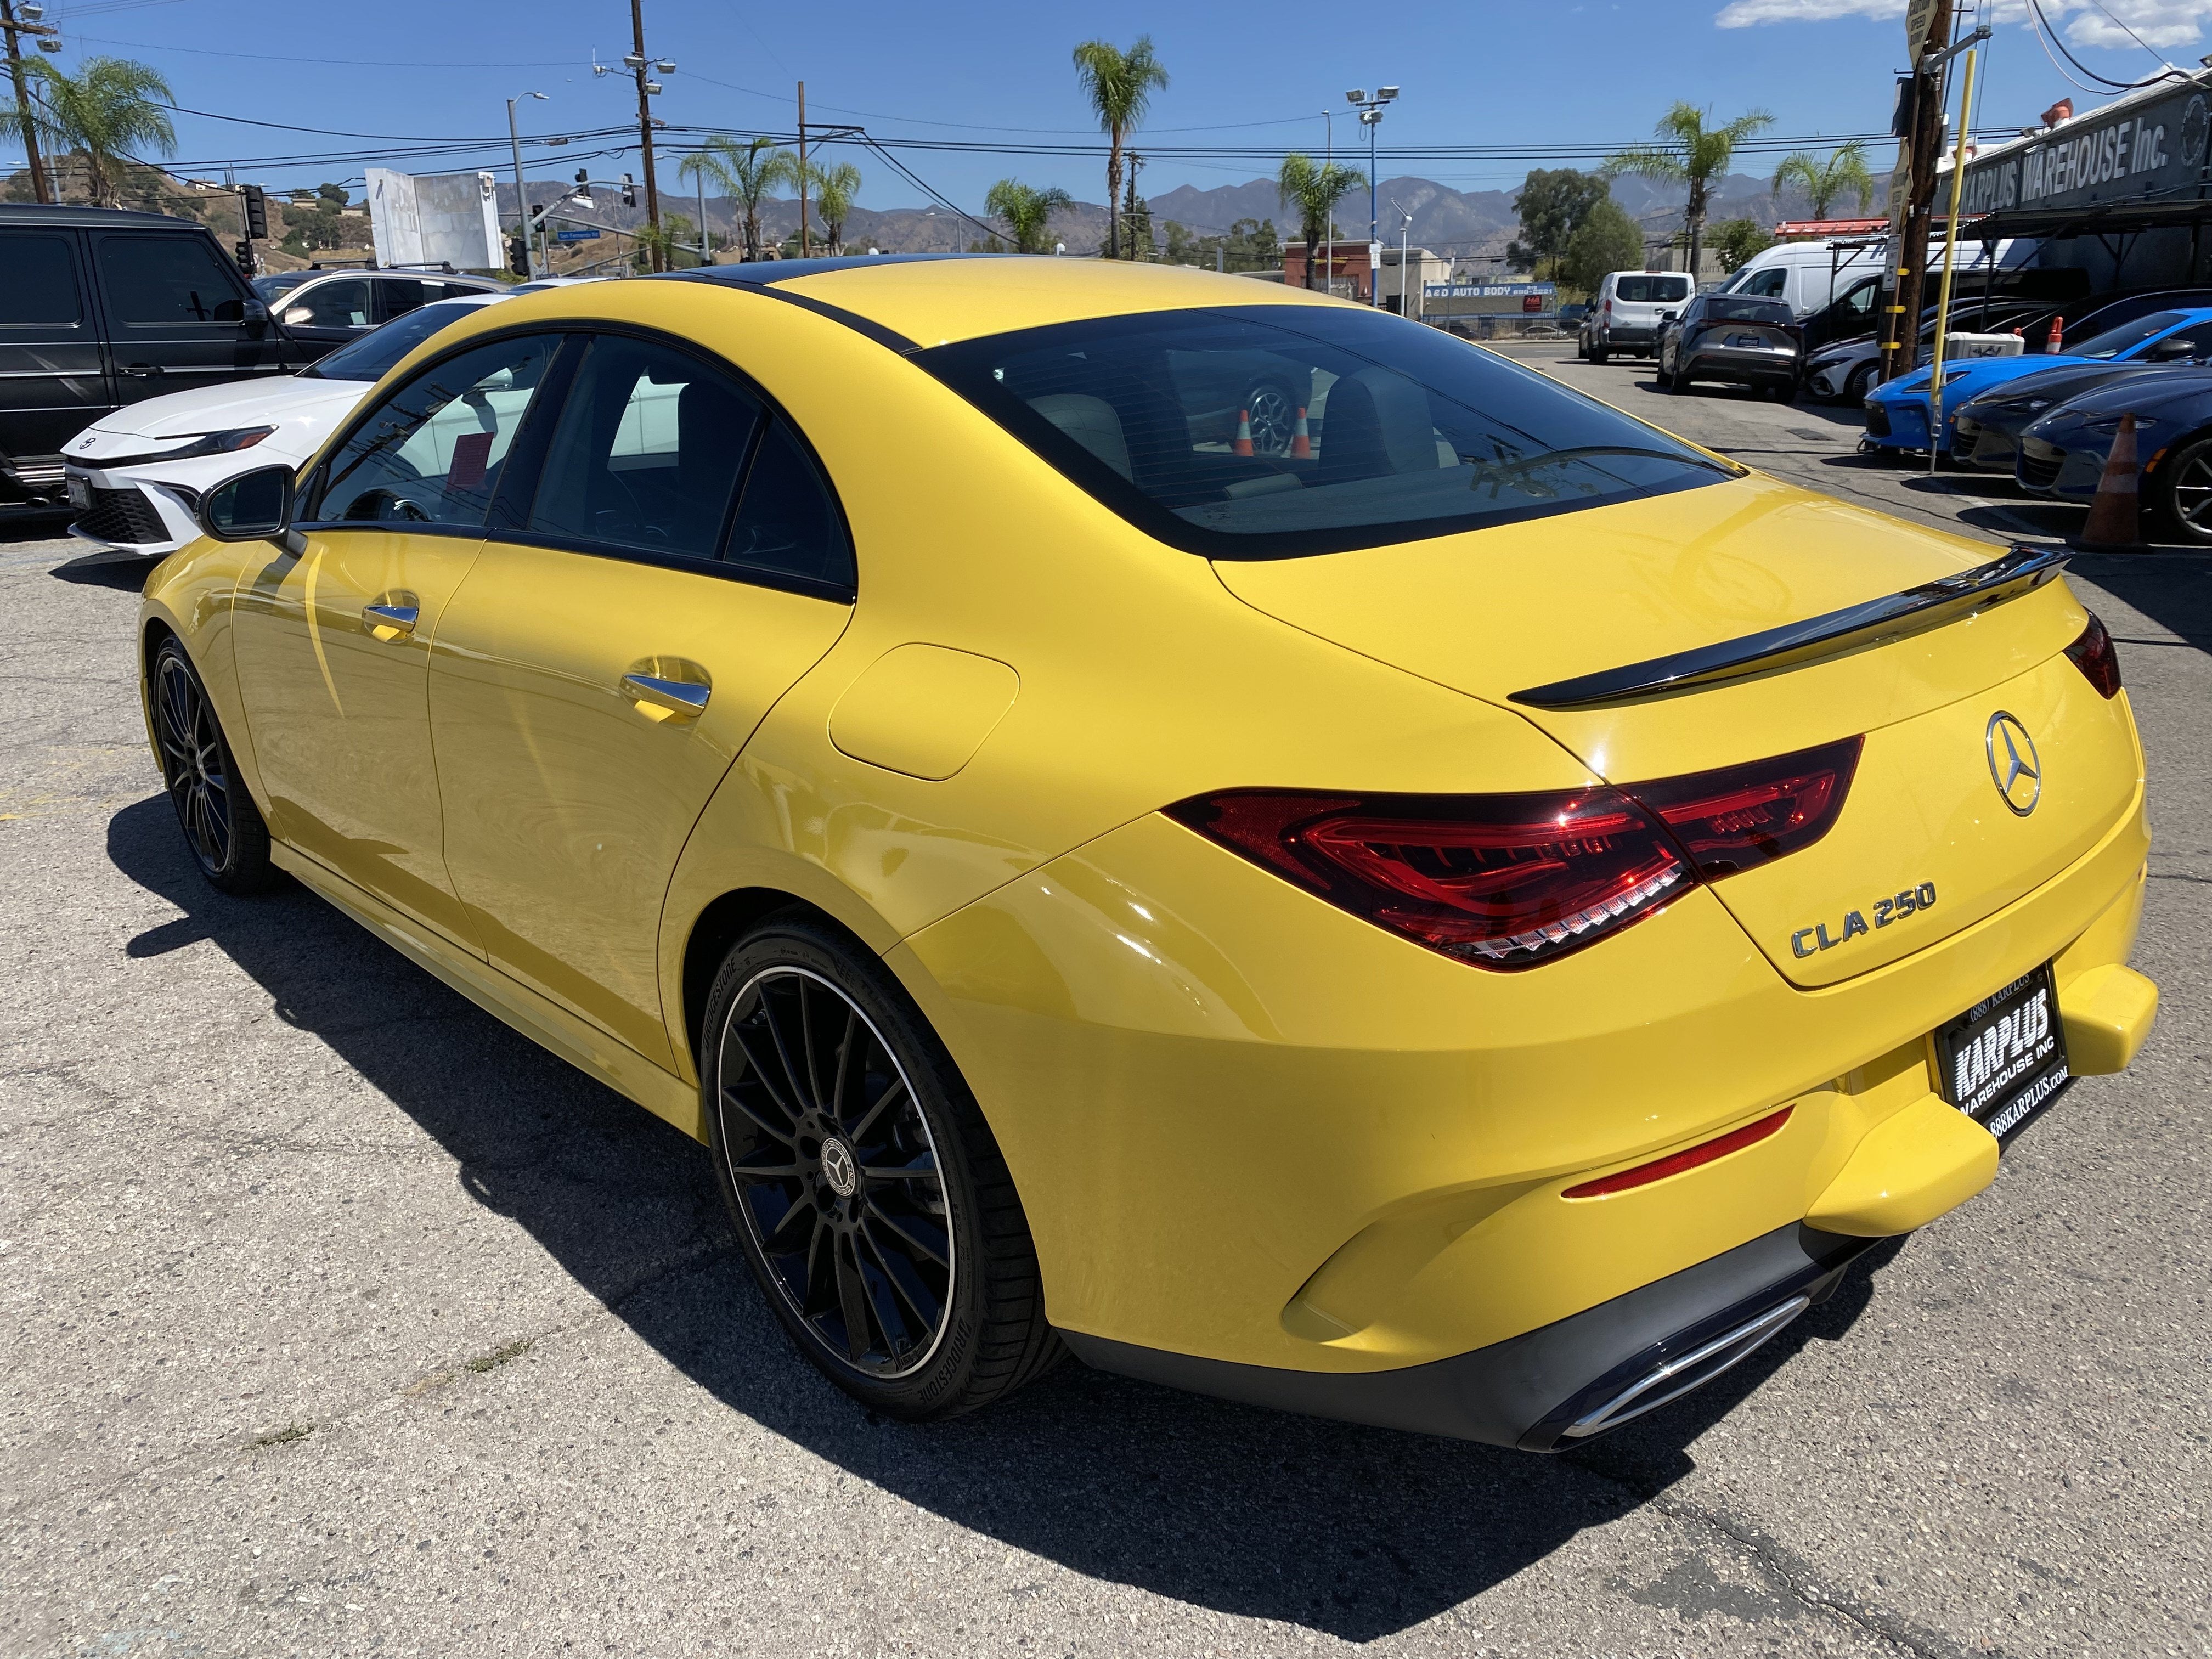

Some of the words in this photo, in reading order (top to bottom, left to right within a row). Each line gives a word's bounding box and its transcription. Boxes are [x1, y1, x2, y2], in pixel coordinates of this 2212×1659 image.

[1910, 14, 1926, 31] SPEED
[1960, 161, 2017, 215] KARPLUS
[2021, 121, 2132, 202] WAREHOUSE
[2131, 117, 2169, 174] Inc.
[1453, 287, 1480, 296] AUTO
[1483, 286, 1511, 296] BODY
[1887, 266, 1894, 282] 5
[1792, 910, 1870, 958] CLA
[1872, 881, 1937, 929] 250
[702, 956, 737, 1053] BRIDGESTONE
[1970, 998, 1990, 1023] (888)
[1991, 973, 2030, 1008] KARPLUS
[1955, 988, 2049, 1102] KARPLUS
[1960, 1052, 2034, 1116] WAREHOUSE
[2036, 1035, 2055, 1060] INC
[1989, 1065, 2069, 1139] 888KARPLUS.COM
[917, 1317, 972, 1404] BRIDGESTONE
